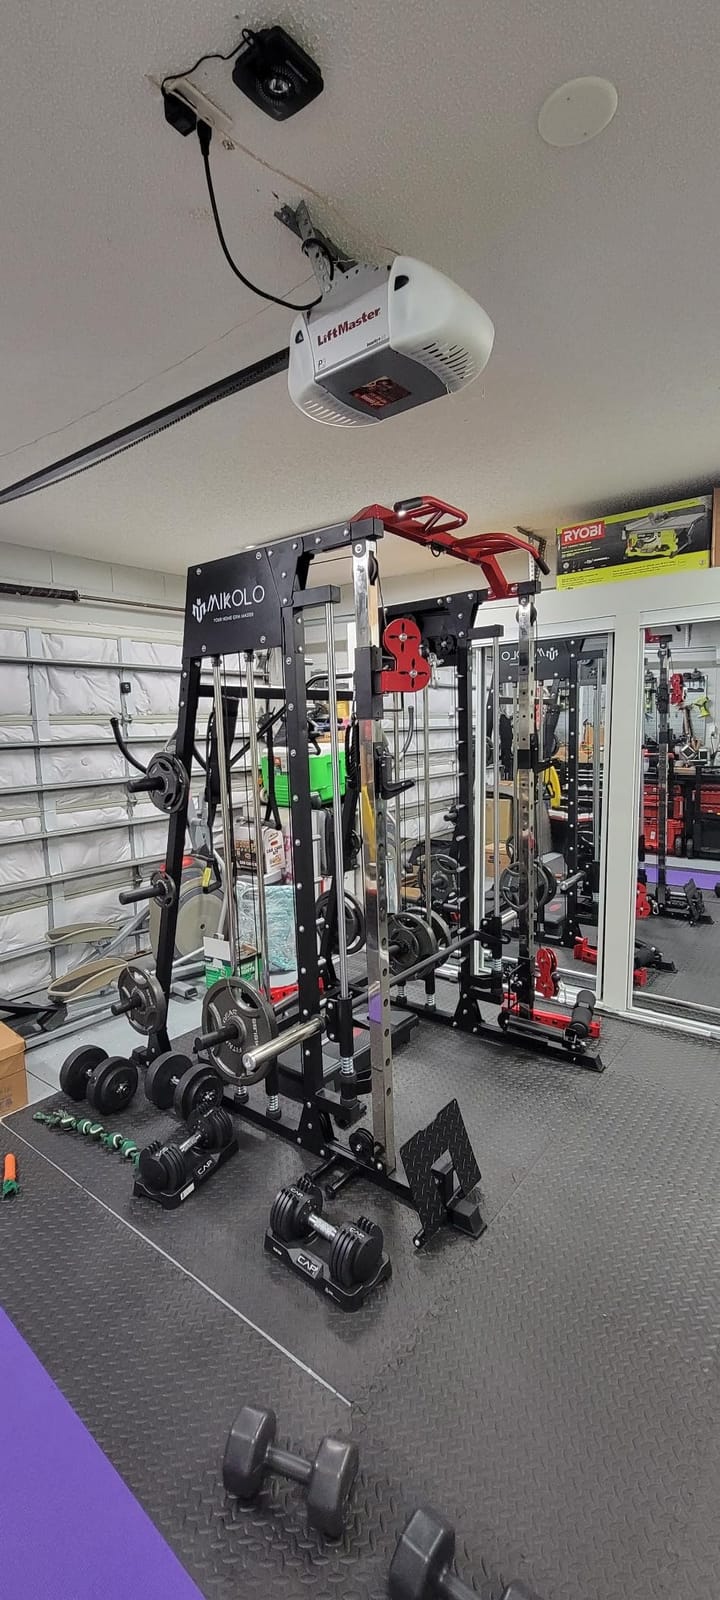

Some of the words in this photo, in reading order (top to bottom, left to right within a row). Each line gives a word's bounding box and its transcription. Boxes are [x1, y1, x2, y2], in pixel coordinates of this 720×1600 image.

[317, 307, 381, 346] LiftMaster
[563, 524, 602, 542] RYOBI
[207, 585, 265, 613] MIKOLO
[198, 1160, 212, 1175] CAP
[297, 1255, 319, 1273] CAP
